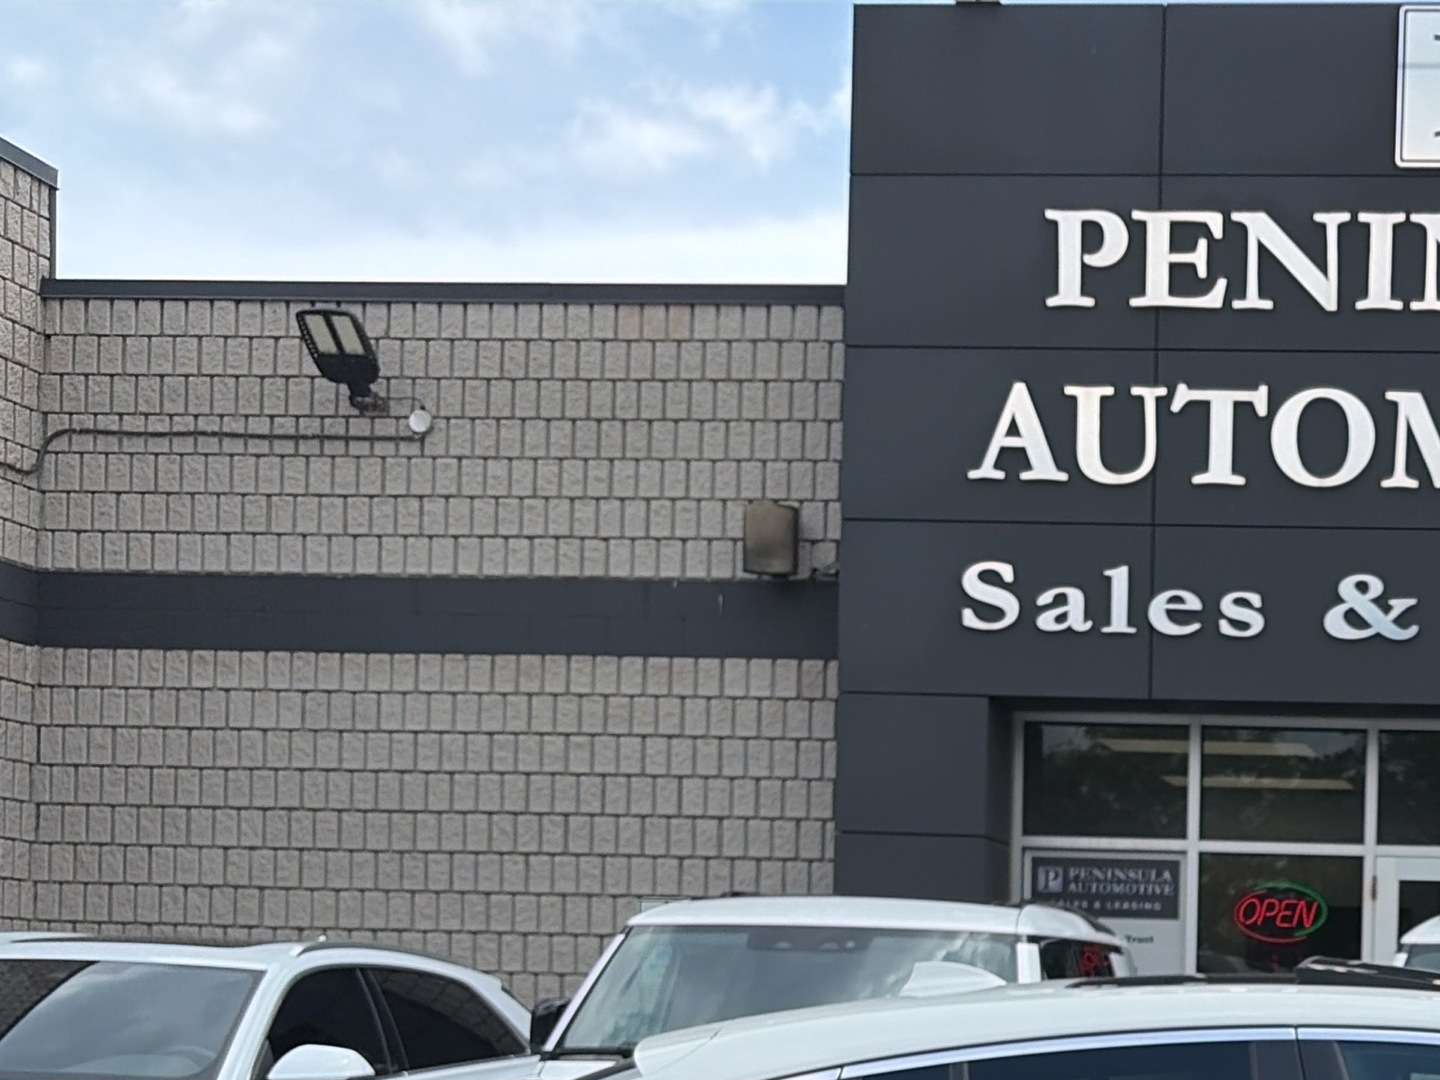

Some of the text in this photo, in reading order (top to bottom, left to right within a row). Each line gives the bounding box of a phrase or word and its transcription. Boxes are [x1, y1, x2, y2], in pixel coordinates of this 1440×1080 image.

[961, 560, 1265, 638] Sales
[1323, 573, 1420, 641] &
[1042, 867, 1058, 892] P
[1068, 866, 1173, 882] PENINSULA
[1068, 882, 1176, 896] AUTOMOTIVE
[1106, 901, 1162, 911] LEASING
[1239, 898, 1319, 928] OPEN
